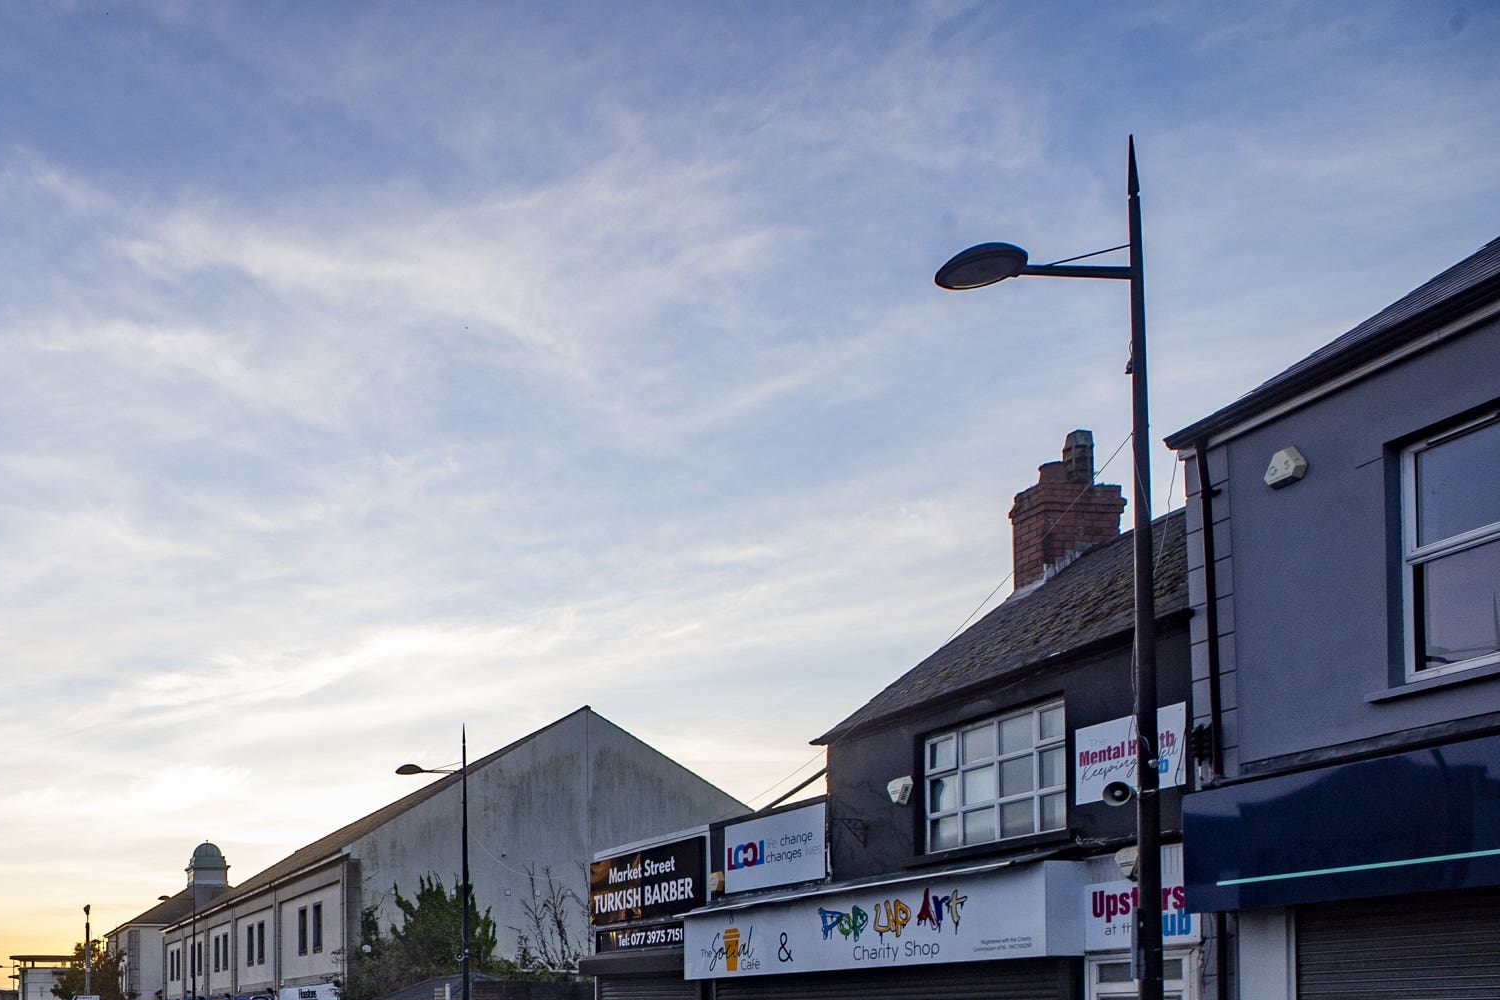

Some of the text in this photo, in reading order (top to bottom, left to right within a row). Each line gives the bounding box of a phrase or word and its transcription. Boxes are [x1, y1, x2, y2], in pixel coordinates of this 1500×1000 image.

[1079, 731, 1175, 767] Mental Hth
[1081, 758, 1137, 784] Keeping
[1158, 737, 1179, 757] ell
[780, 831, 813, 846] change
[765, 848, 802, 864] changes
[608, 856, 675, 884] Market Street
[594, 877, 694, 914] TURKISH BARBER
[1092, 886, 1185, 923] Upstrs
[1104, 909, 1191, 936] at th ub
[618, 928, 683, 947] Tel: 077 3975 7151
[709, 925, 794, 972] Social &
[853, 940, 940, 962] Charity Shop
[701, 949, 712, 958] The
